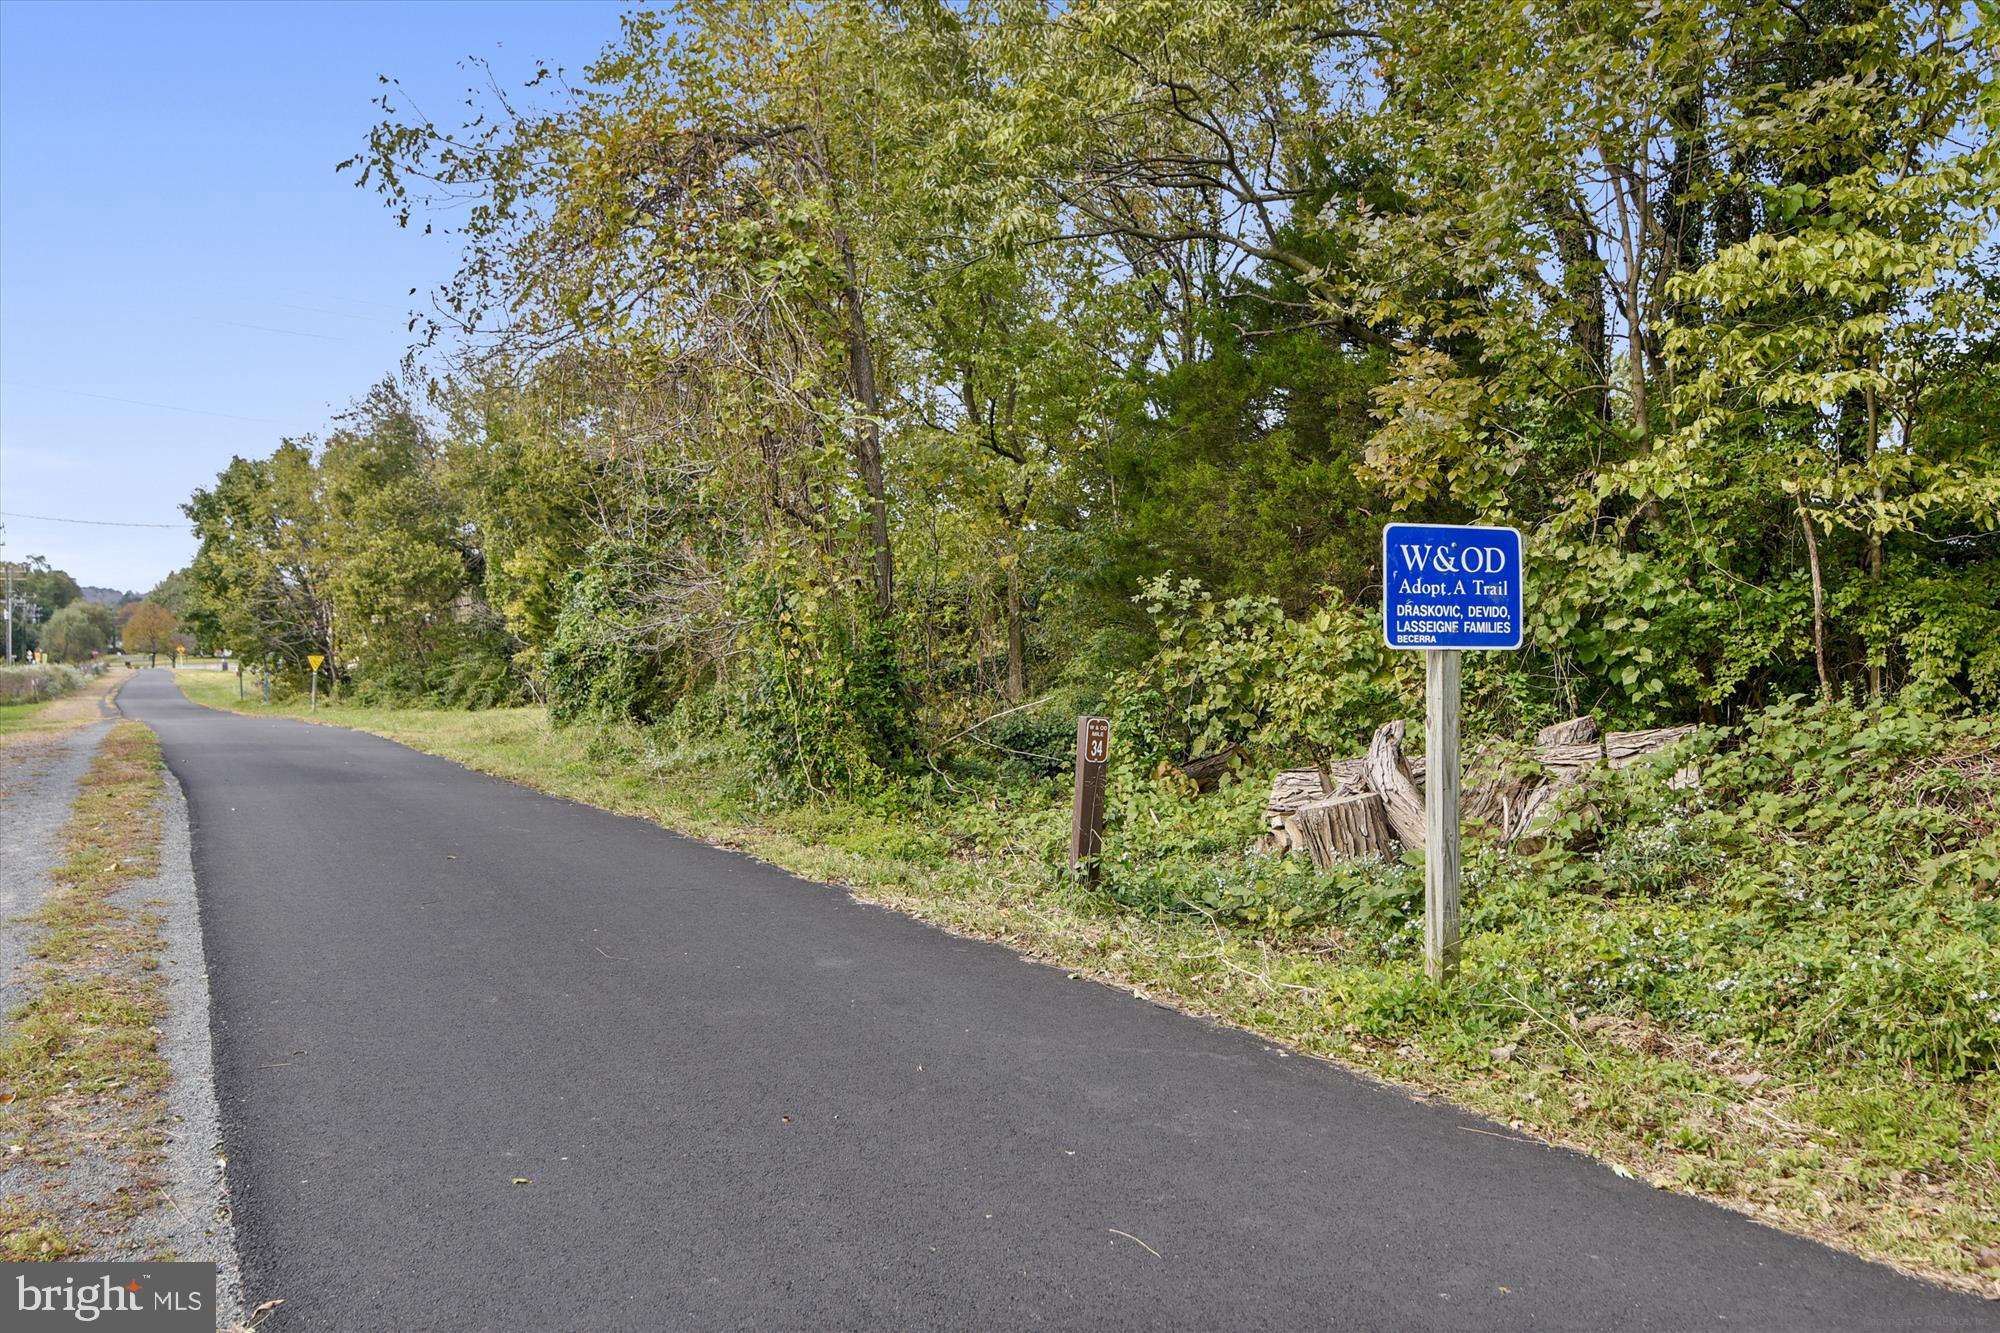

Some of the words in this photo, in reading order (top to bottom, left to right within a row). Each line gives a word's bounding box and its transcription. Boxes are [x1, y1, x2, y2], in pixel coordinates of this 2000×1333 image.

[1400, 544, 1506, 573] W&OD
[1398, 577, 1446, 598] Adopt
[1453, 579, 1466, 595] A
[1472, 580, 1508, 596] Trail
[1397, 604, 1464, 619] DRASKOVIC,
[1468, 606, 1511, 620] DEVIDO,
[1397, 620, 1459, 633] LASSEIGNE
[1464, 621, 1511, 634] FAMILIES
[1397, 635, 1437, 643] BECERRA
[1091, 740, 1102, 756] 34
